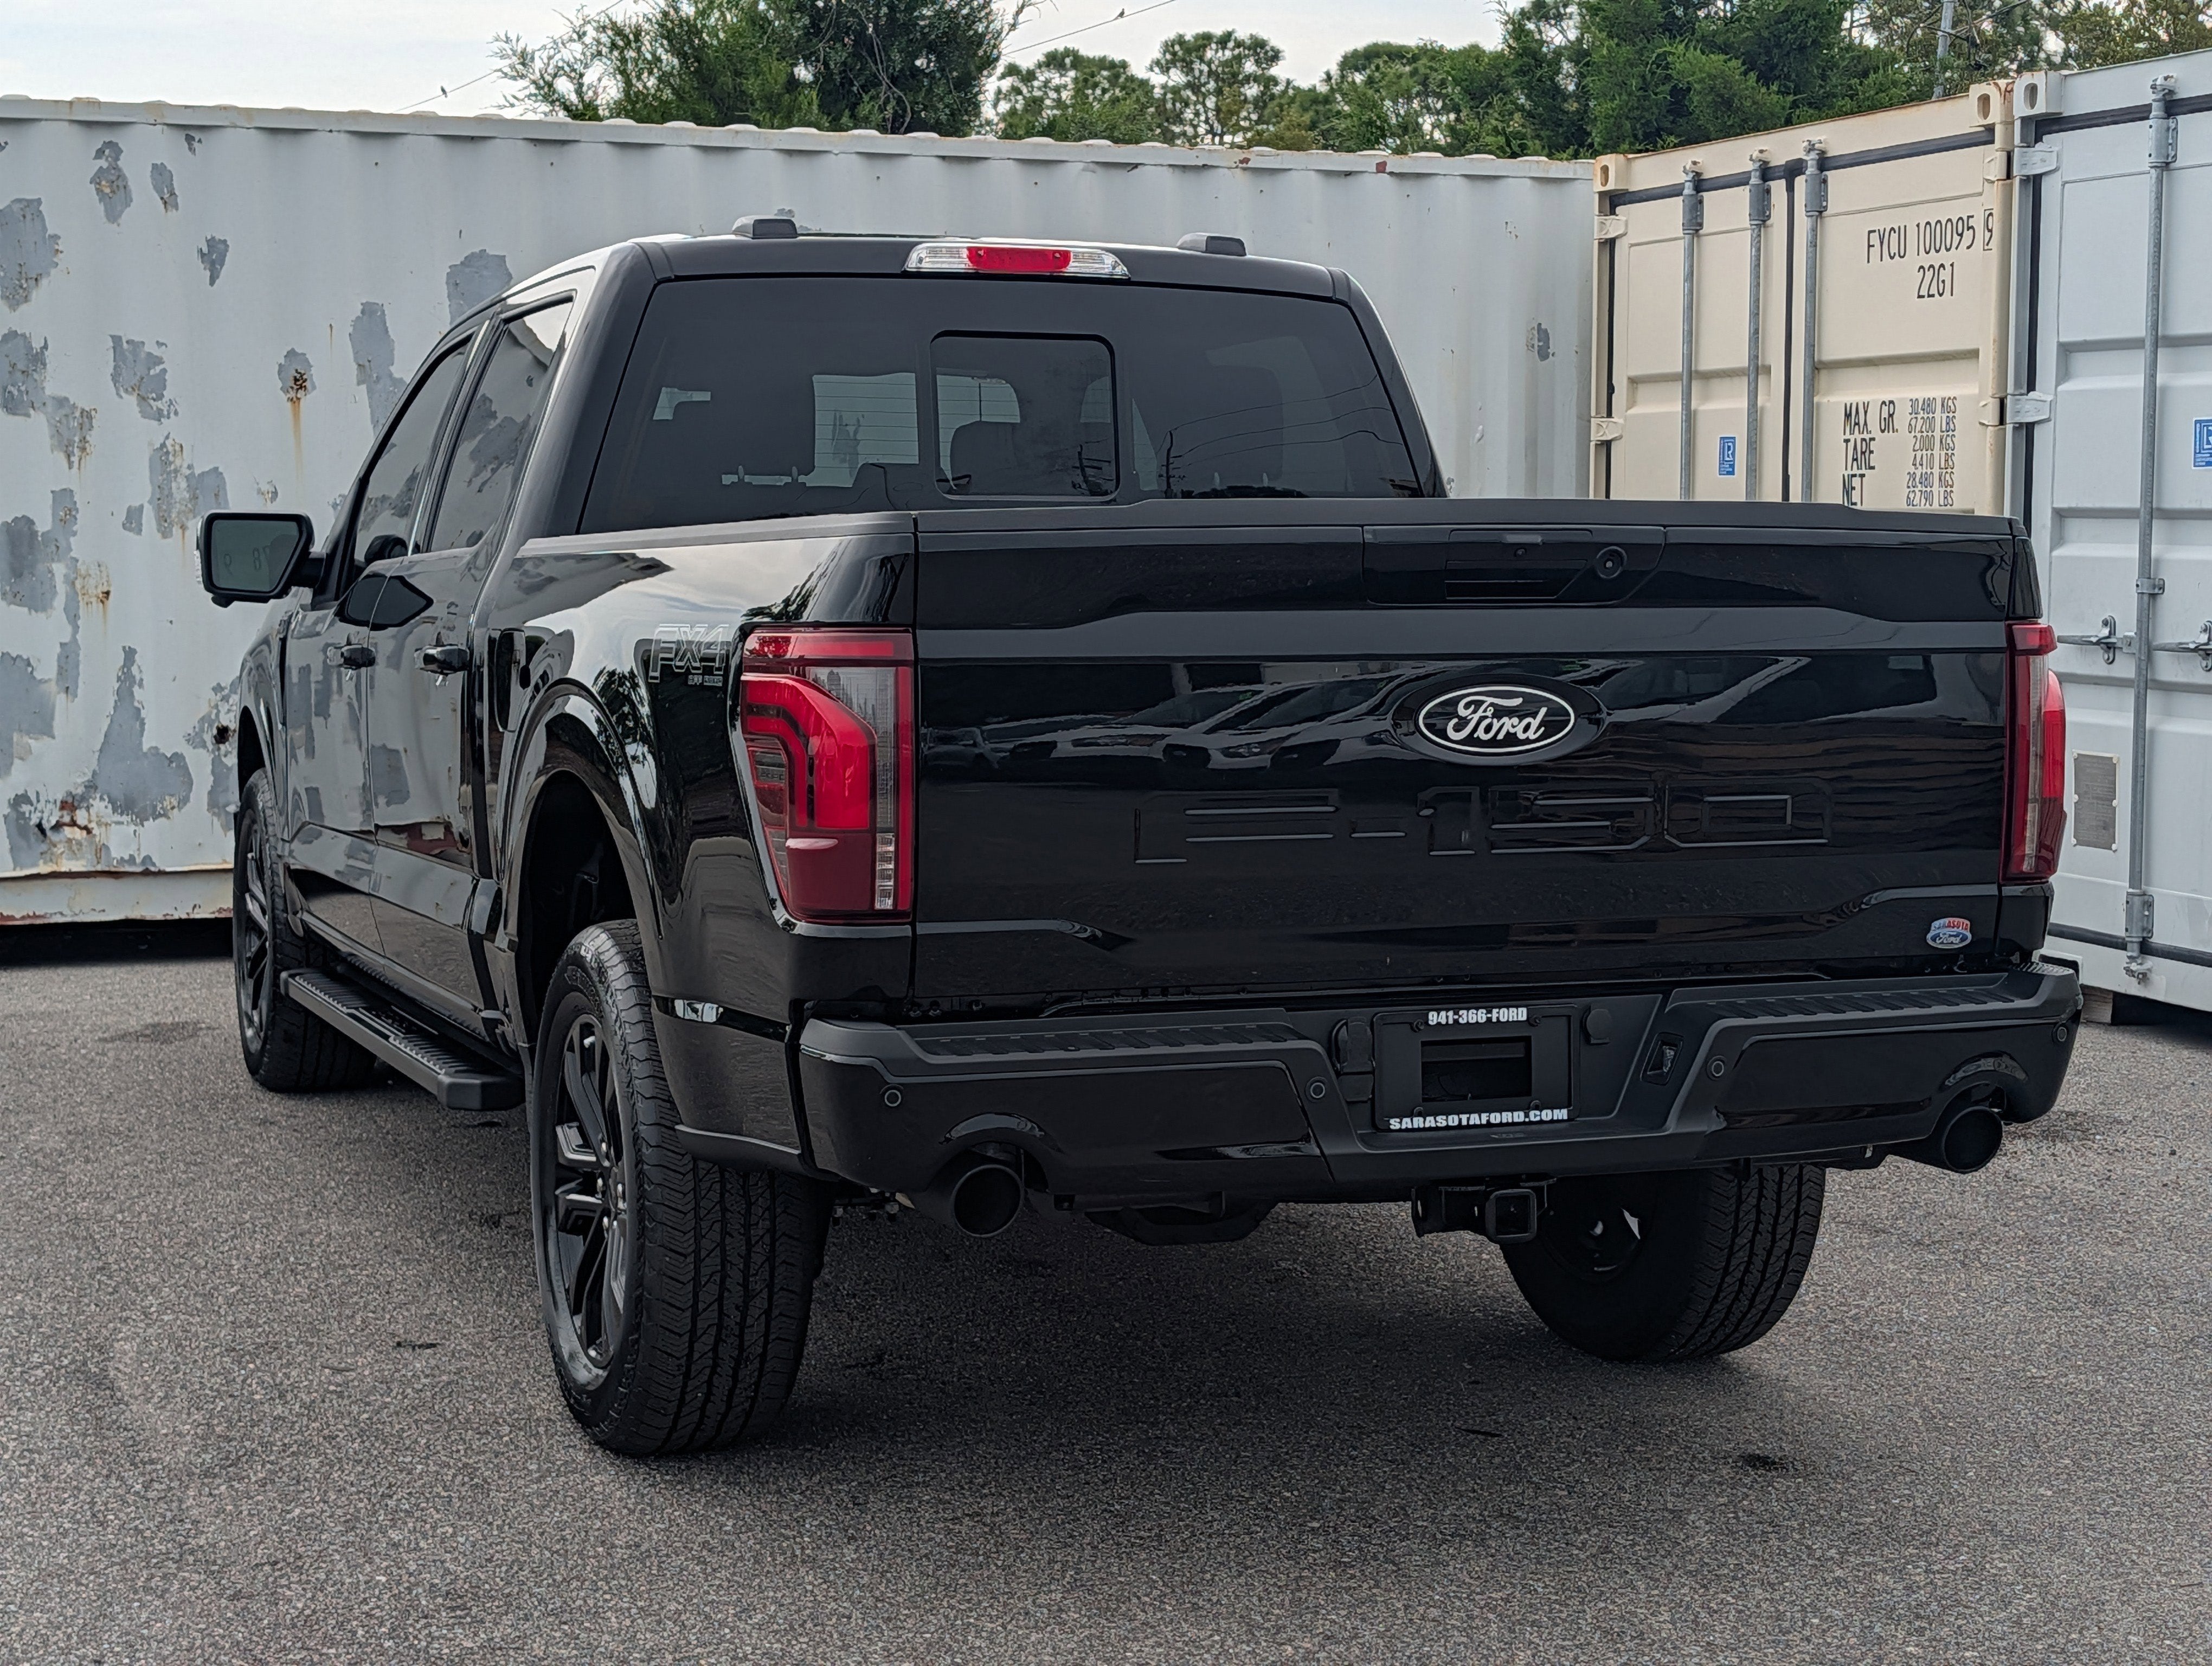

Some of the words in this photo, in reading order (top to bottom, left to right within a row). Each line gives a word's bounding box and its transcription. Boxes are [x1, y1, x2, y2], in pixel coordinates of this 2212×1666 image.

[1867, 225, 1907, 264] FYCU
[1915, 215, 1976, 256] 100095
[1986, 212, 1994, 246] 9
[1917, 261, 1954, 299] 22G1
[1843, 401, 1872, 435] MAX.
[1879, 400, 1899, 434] GR.
[1940, 396, 1957, 414] KGS
[1939, 415, 1956, 433] LBS
[1843, 437, 1876, 471] TARE
[1939, 434, 1956, 451] KGS
[1938, 452, 1955, 470] LBS
[1842, 473, 1866, 507] NET
[1938, 471, 1954, 488] KGS
[1938, 489, 1954, 507] LBS
[648, 624, 730, 683] FX4
[1446, 695, 1547, 741] Ford
[1935, 932, 1963, 944] Ford
[1428, 1007, 1528, 1026] 941-366-FORD
[1389, 1108, 1568, 1130] SARASOTAFORD.COM
